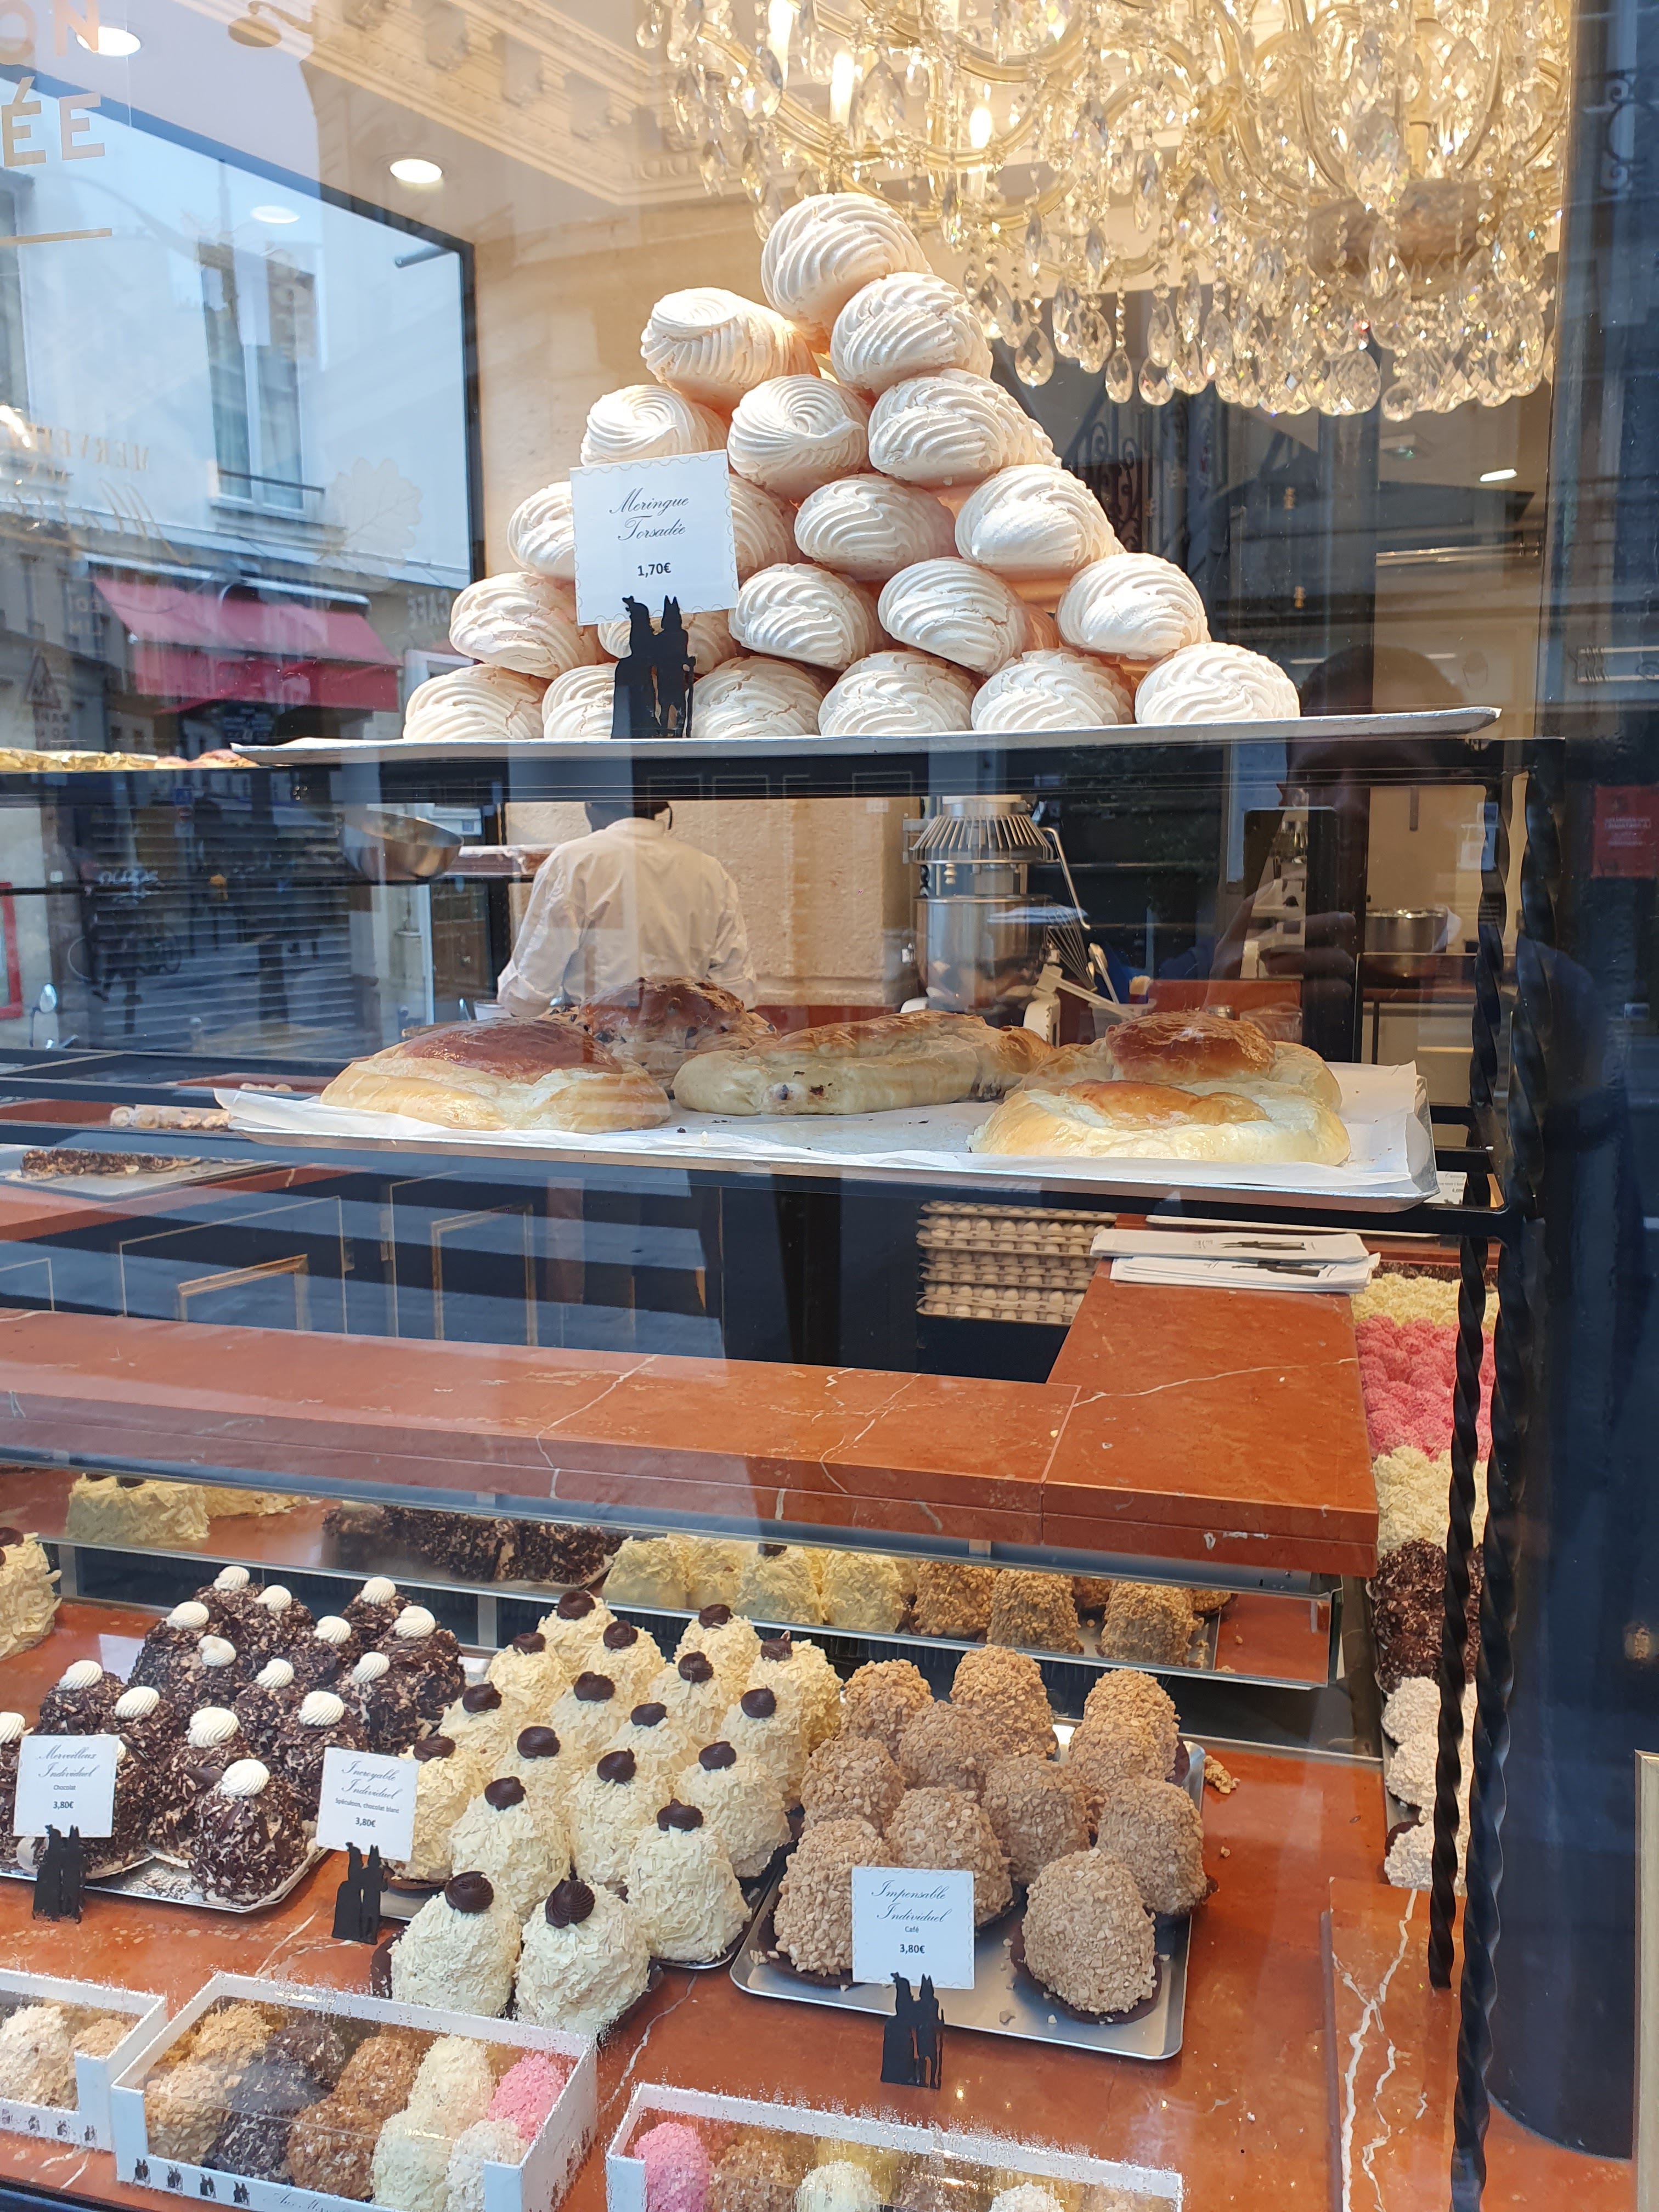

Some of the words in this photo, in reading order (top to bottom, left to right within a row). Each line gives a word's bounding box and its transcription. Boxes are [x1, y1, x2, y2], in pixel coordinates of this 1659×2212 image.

[609, 487, 690, 516] Meringue
[617, 515, 686, 541] Torsadée
[637, 562, 672, 578] 1,70€
[38, 1762, 100, 1778] Individuel
[341, 1760, 400, 1782] Incroyable
[341, 1779, 403, 1799] Individuel
[53, 1801, 75, 1810] 3,80€
[355, 1816, 376, 1827] 3,80€
[871, 1880, 950, 1903] Impensable
[876, 1903, 953, 1923] Individuel
[900, 1944, 926, 1954] 3,80€
